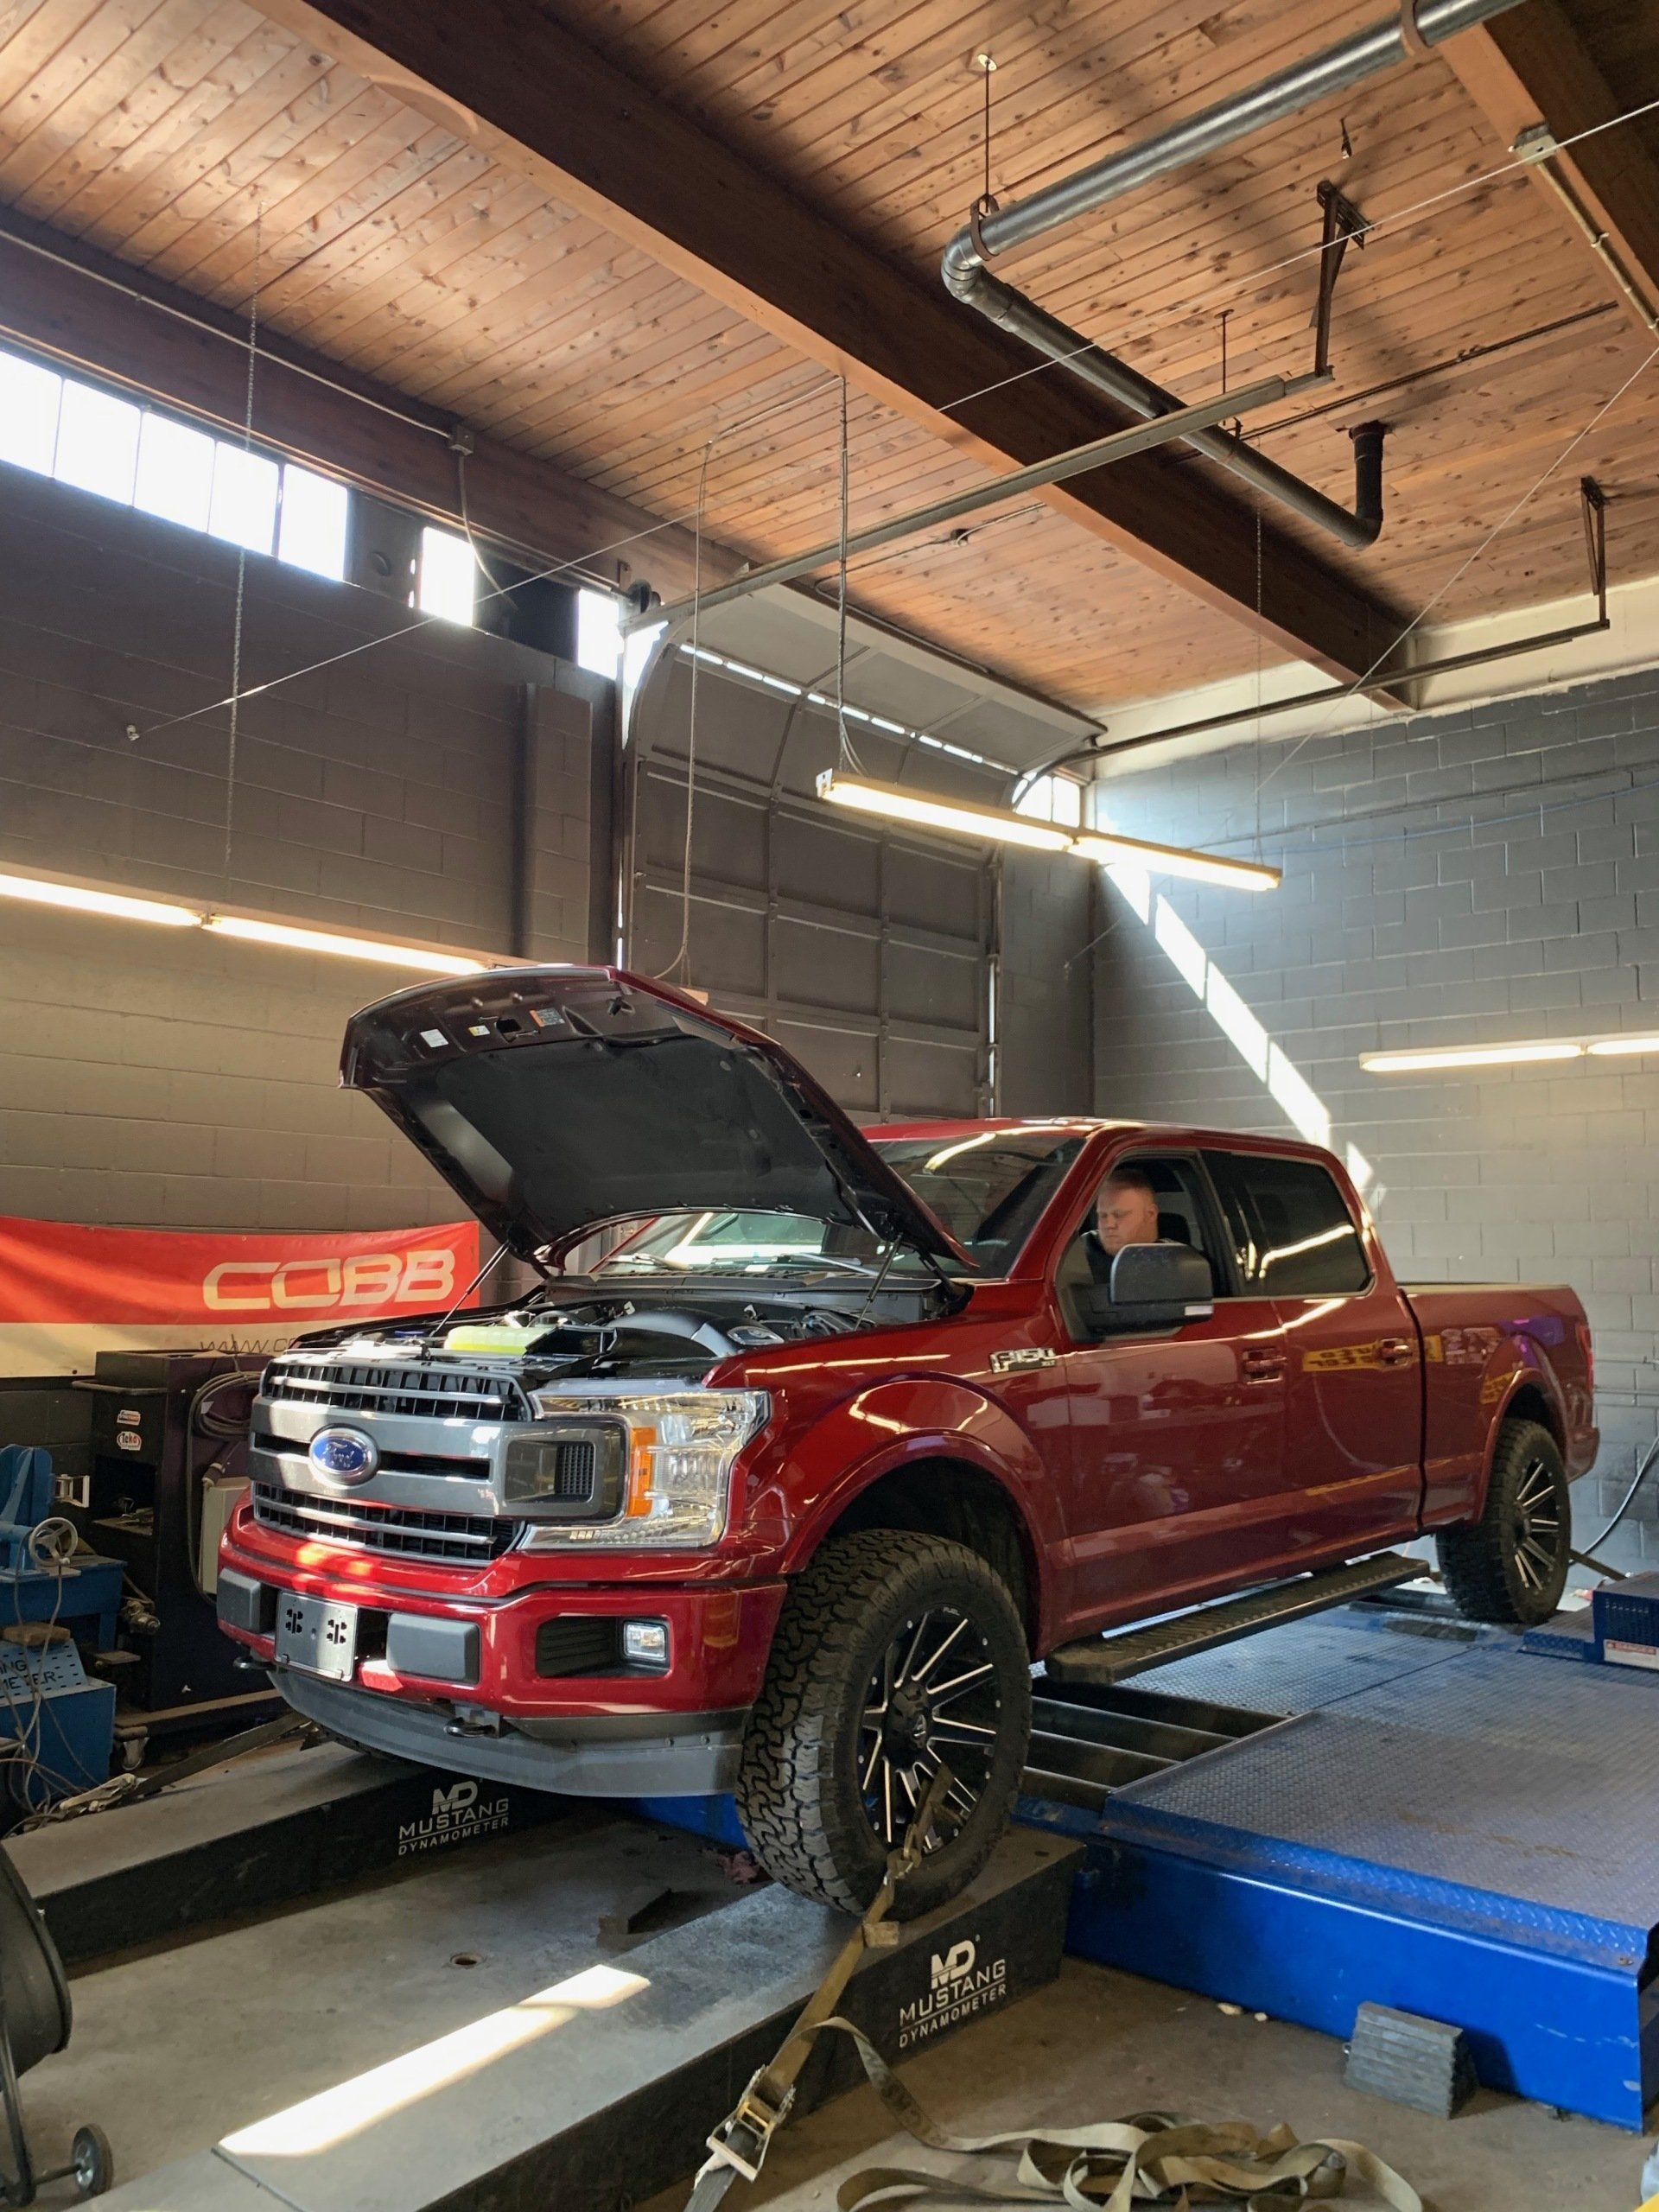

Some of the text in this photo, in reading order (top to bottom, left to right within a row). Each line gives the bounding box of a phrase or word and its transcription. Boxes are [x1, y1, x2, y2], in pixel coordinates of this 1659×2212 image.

[203, 1249, 455, 1310] COBB
[398, 1798, 509, 1840] MUSTANG
[398, 1816, 509, 1855] DYNAMOMETER
[899, 1958, 1006, 2026] MUSTANG
[899, 1983, 1007, 2049] DYNAMOMETER
